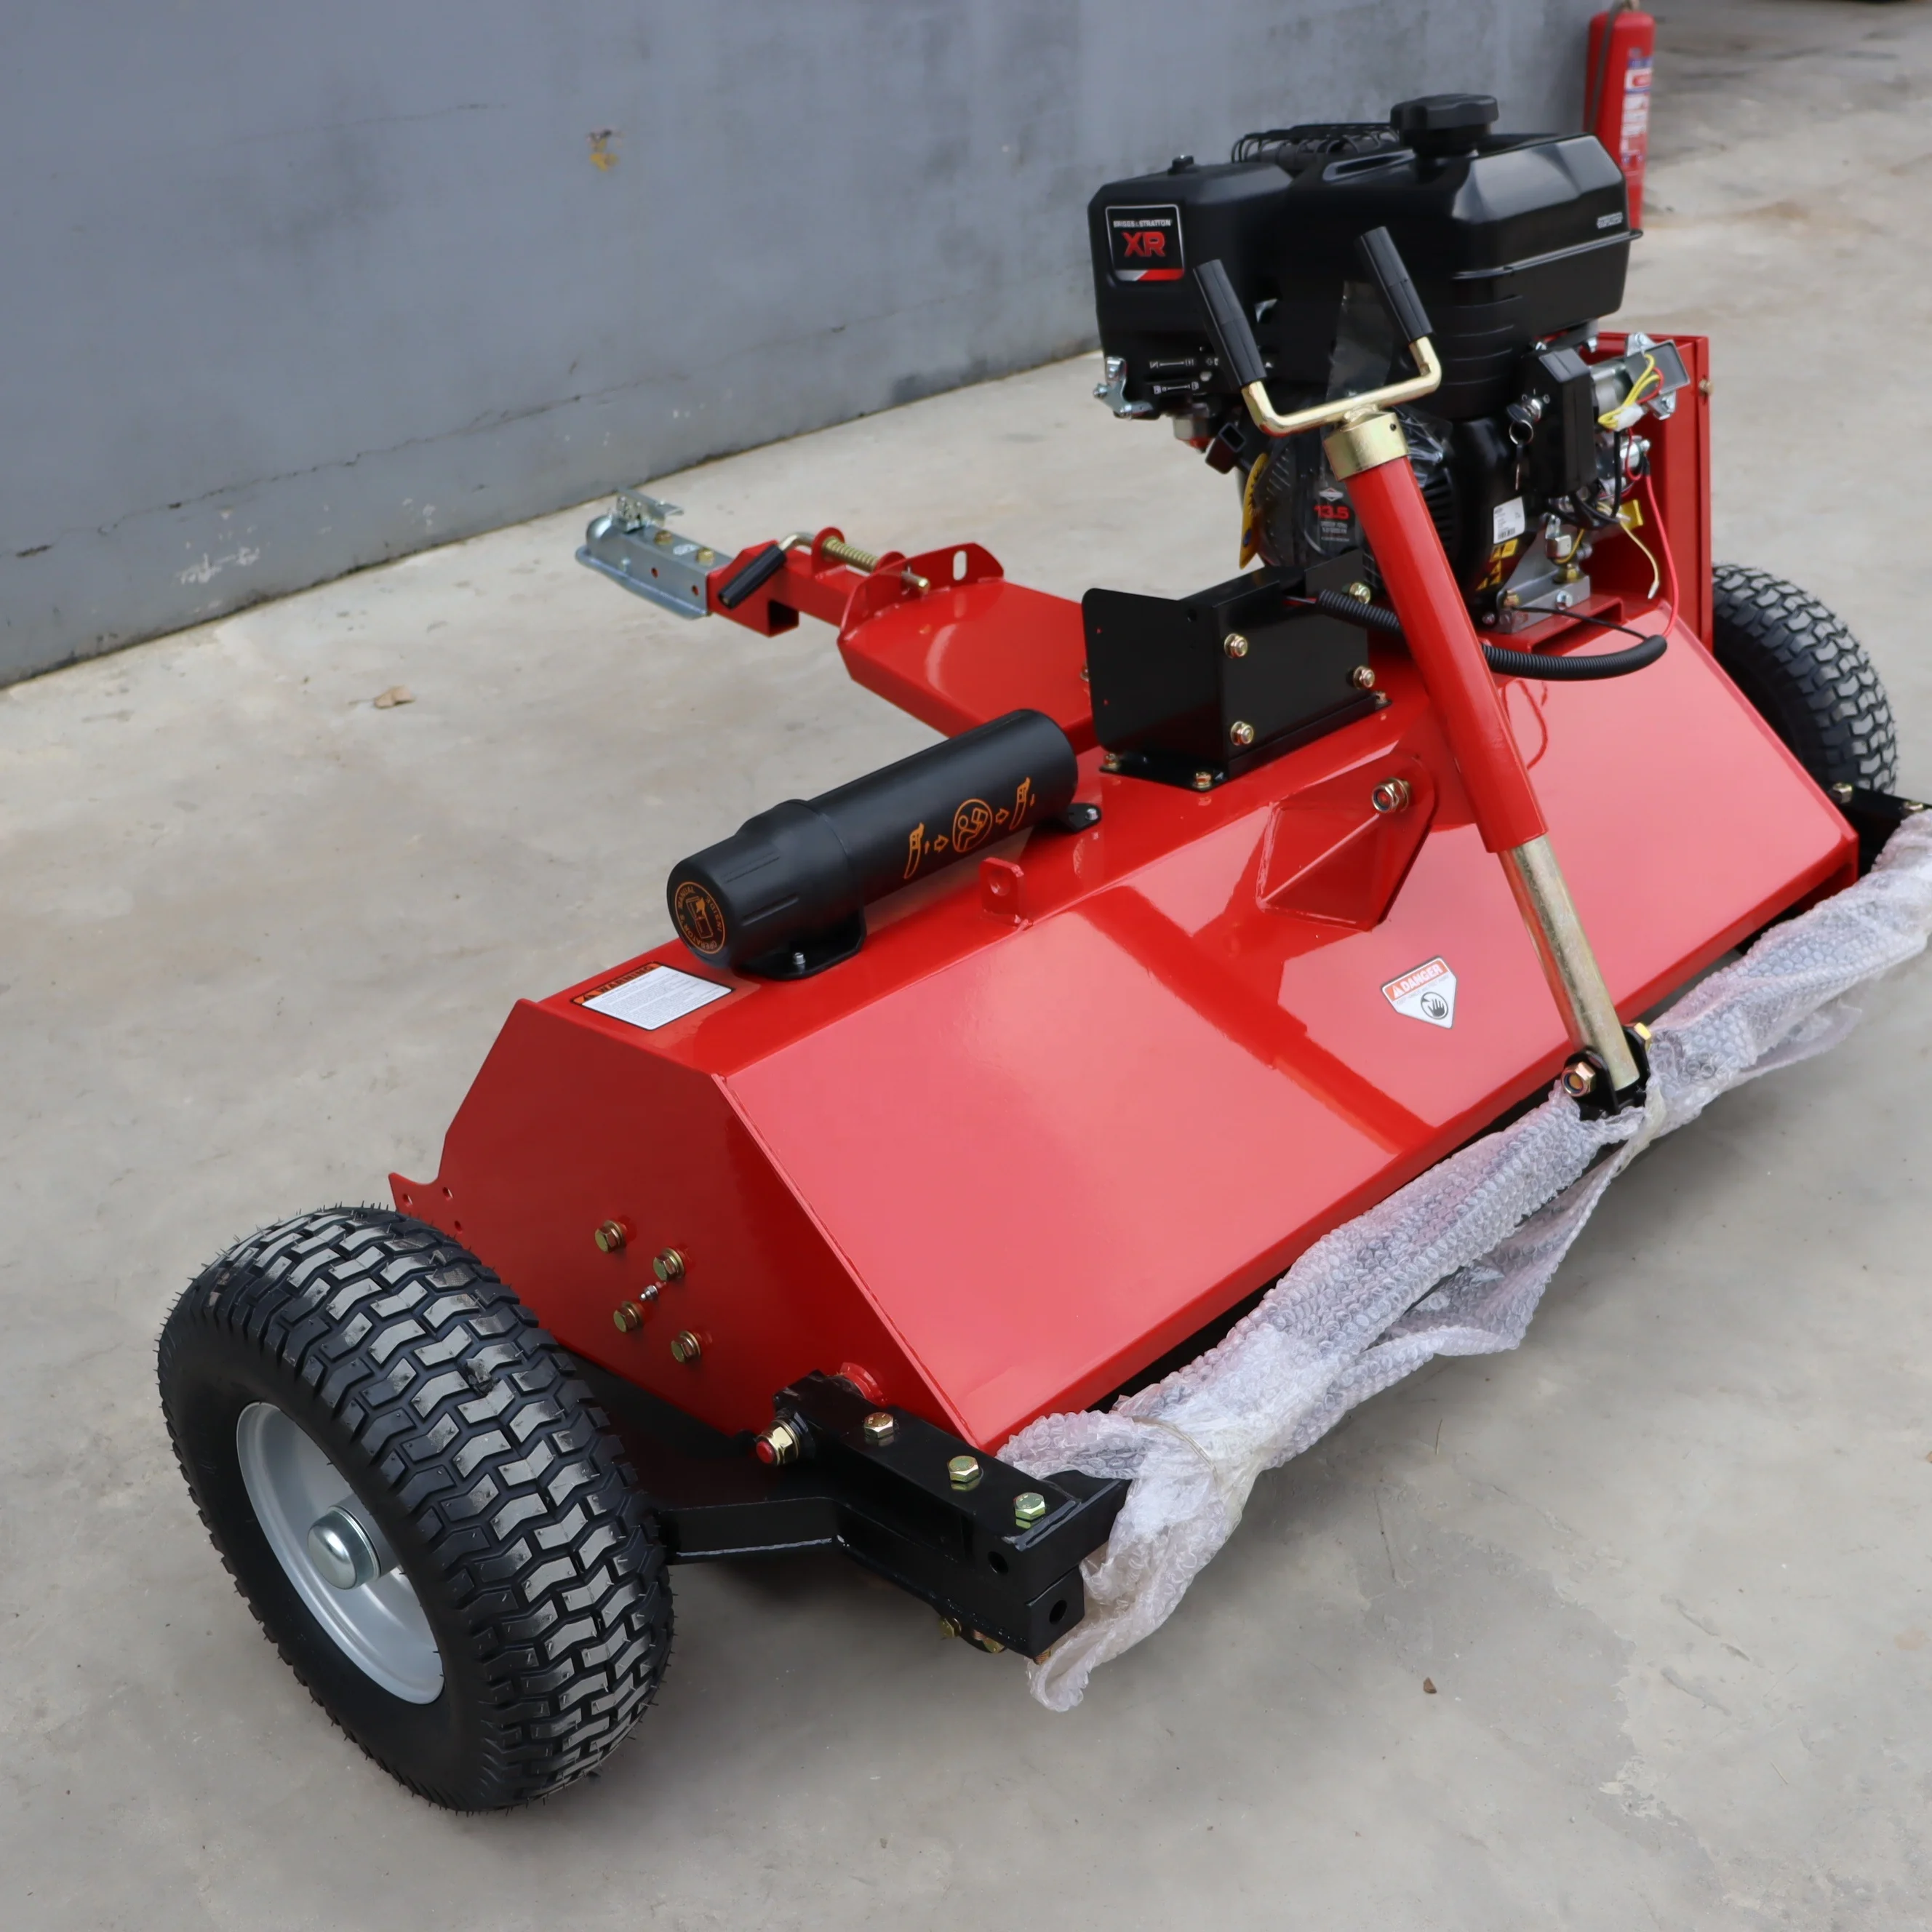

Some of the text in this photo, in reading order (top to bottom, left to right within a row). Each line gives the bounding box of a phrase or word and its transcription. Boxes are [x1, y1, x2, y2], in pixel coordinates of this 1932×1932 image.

[1122, 231, 1167, 258] XR
[1314, 505, 1349, 519] 13.5
[599, 965, 653, 994] WARNING
[1400, 963, 1443, 993] DANGER
